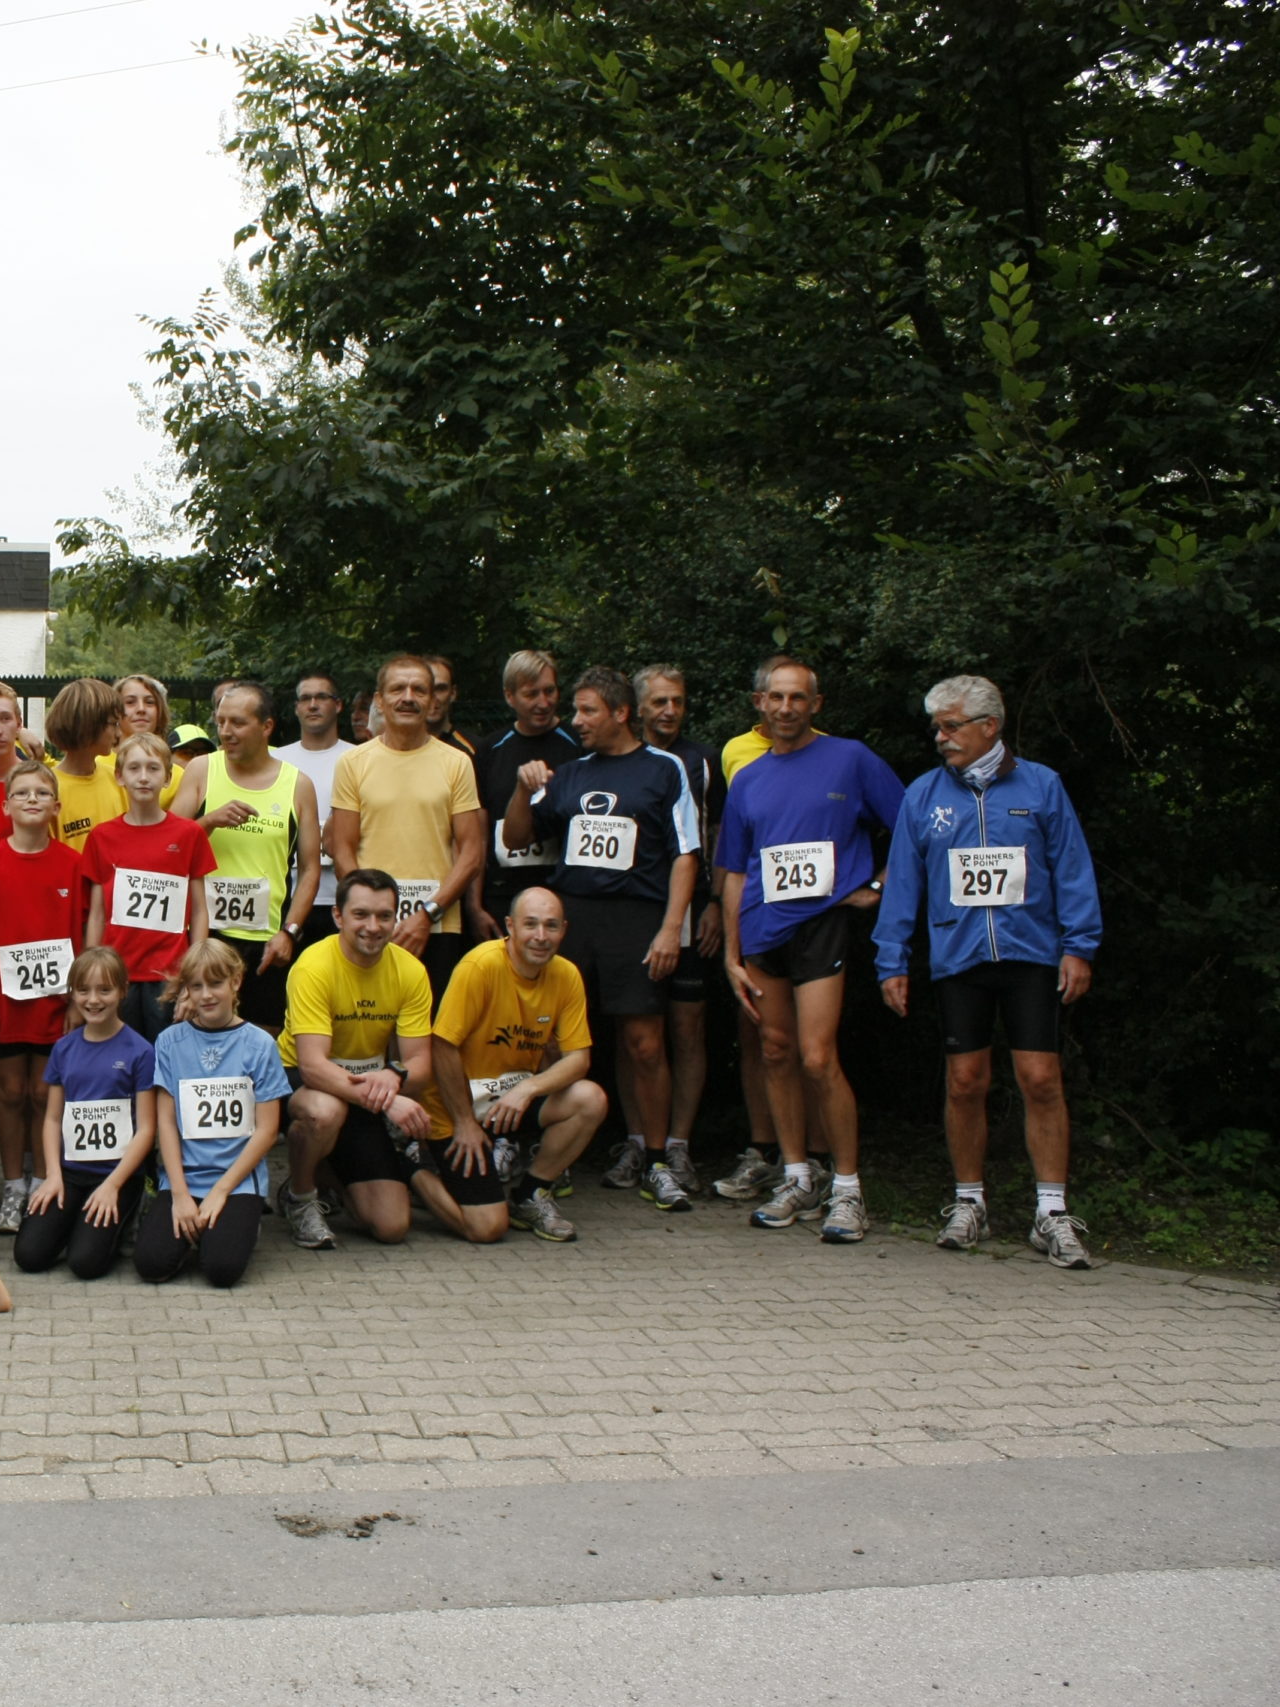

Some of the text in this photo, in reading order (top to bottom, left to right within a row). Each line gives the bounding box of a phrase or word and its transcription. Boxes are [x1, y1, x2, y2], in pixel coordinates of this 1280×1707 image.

[227, 825, 264, 834] MENDEN
[592, 826, 614, 834] POINT
[593, 821, 628, 830] RUNNERS
[578, 833, 620, 860] 260
[784, 848, 823, 857] RUNNERS
[973, 853, 1014, 861] RUNNERS
[775, 863, 817, 892] 243
[142, 877, 180, 889] RUNNERS
[227, 882, 262, 890] RUNNERS
[962, 869, 1009, 896] 297
[141, 883, 166, 893] POINT
[126, 891, 170, 922] 271
[214, 896, 256, 922] 264
[25, 945, 63, 956] RUNNERS
[25, 953, 50, 962] POINT
[17, 961, 61, 991] 245
[345, 1063, 379, 1071] RUNNERS
[210, 1082, 249, 1091] RUNNERS
[82, 1105, 121, 1114] RUNNERS
[198, 1099, 244, 1128] 249
[82, 1112, 108, 1121] POINT
[74, 1122, 117, 1151] 248
